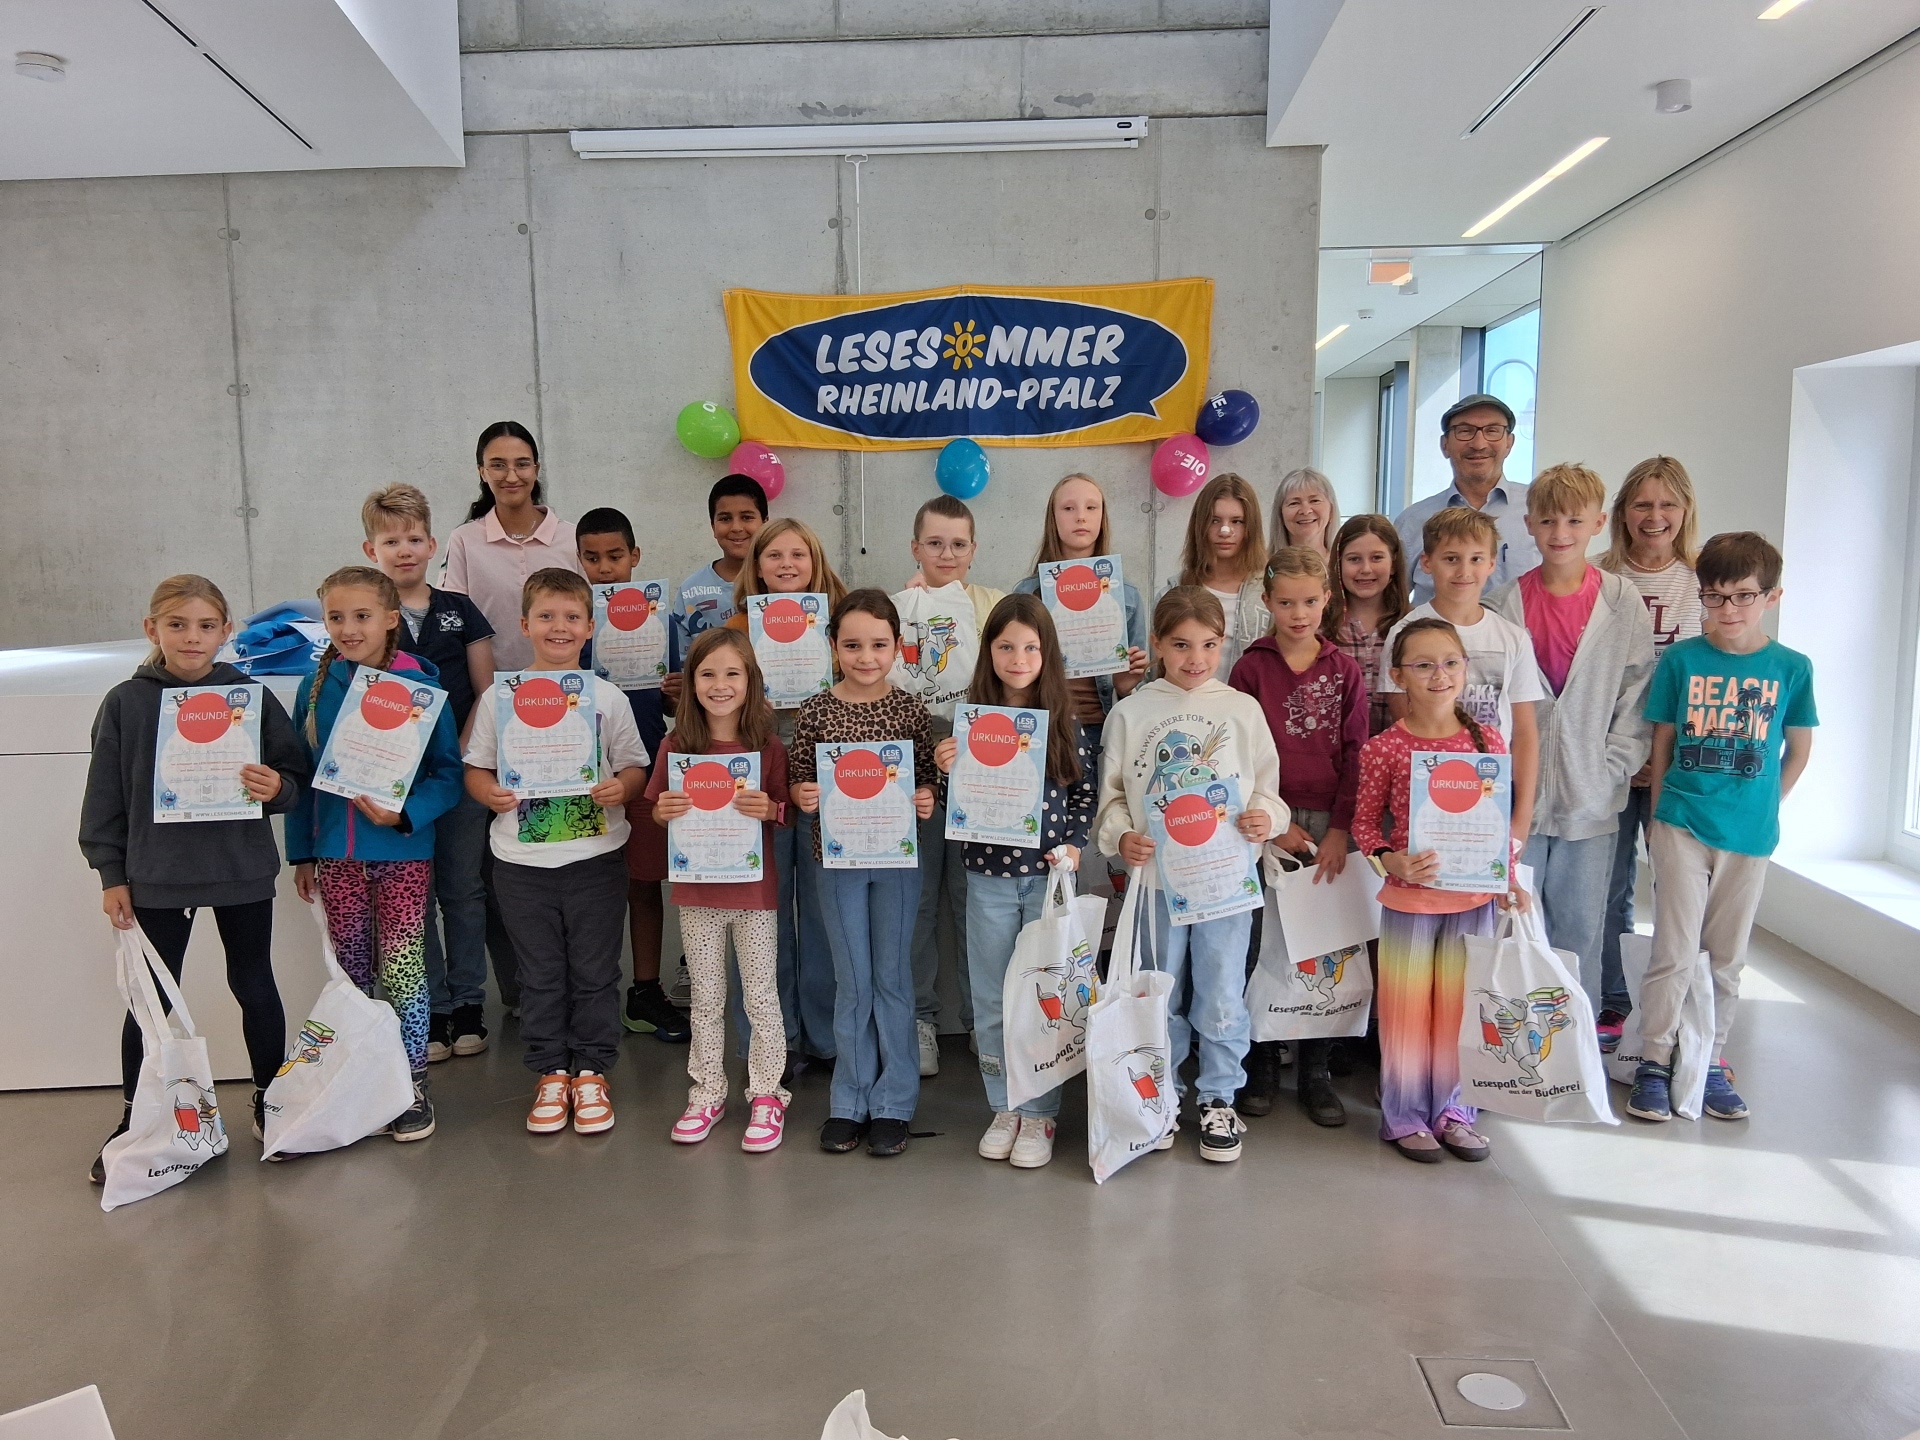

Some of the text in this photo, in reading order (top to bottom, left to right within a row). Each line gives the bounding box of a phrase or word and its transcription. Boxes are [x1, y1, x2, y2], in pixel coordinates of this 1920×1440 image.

[815, 324, 1125, 373] LESESOMMER
[817, 375, 1122, 415] RHEINLAND-PFALZ
[1174, 449, 1206, 476] OIE AG
[682, 585, 722, 599] SUNSHINE
[1060, 581, 1098, 592] URKUNDE
[610, 604, 647, 614] URKUNDE
[765, 616, 804, 625] URKUNDE
[1688, 675, 1779, 706] BEACH
[366, 694, 410, 714] URKUNDE
[517, 697, 565, 707] URKUNDE
[181, 711, 229, 722] URKUNDE
[972, 732, 1016, 745] URKUNDE
[1139, 714, 1204, 759] ALWAYS HERE FOR
[838, 769, 884, 778] URKUNDE
[686, 781, 732, 789] URKUNDE
[1432, 780, 1479, 789] URKUNDE
[1168, 810, 1214, 827] URKUNDE
[1268, 1003, 1313, 1014] Lesespaß
[1325, 998, 1362, 1016] Bücherei
[1065, 1052, 1076, 1062] aus
[1472, 1079, 1517, 1090] Lesespaß
[1535, 1081, 1580, 1098] Bücherei
[148, 1163, 199, 1178] Lesespaß
